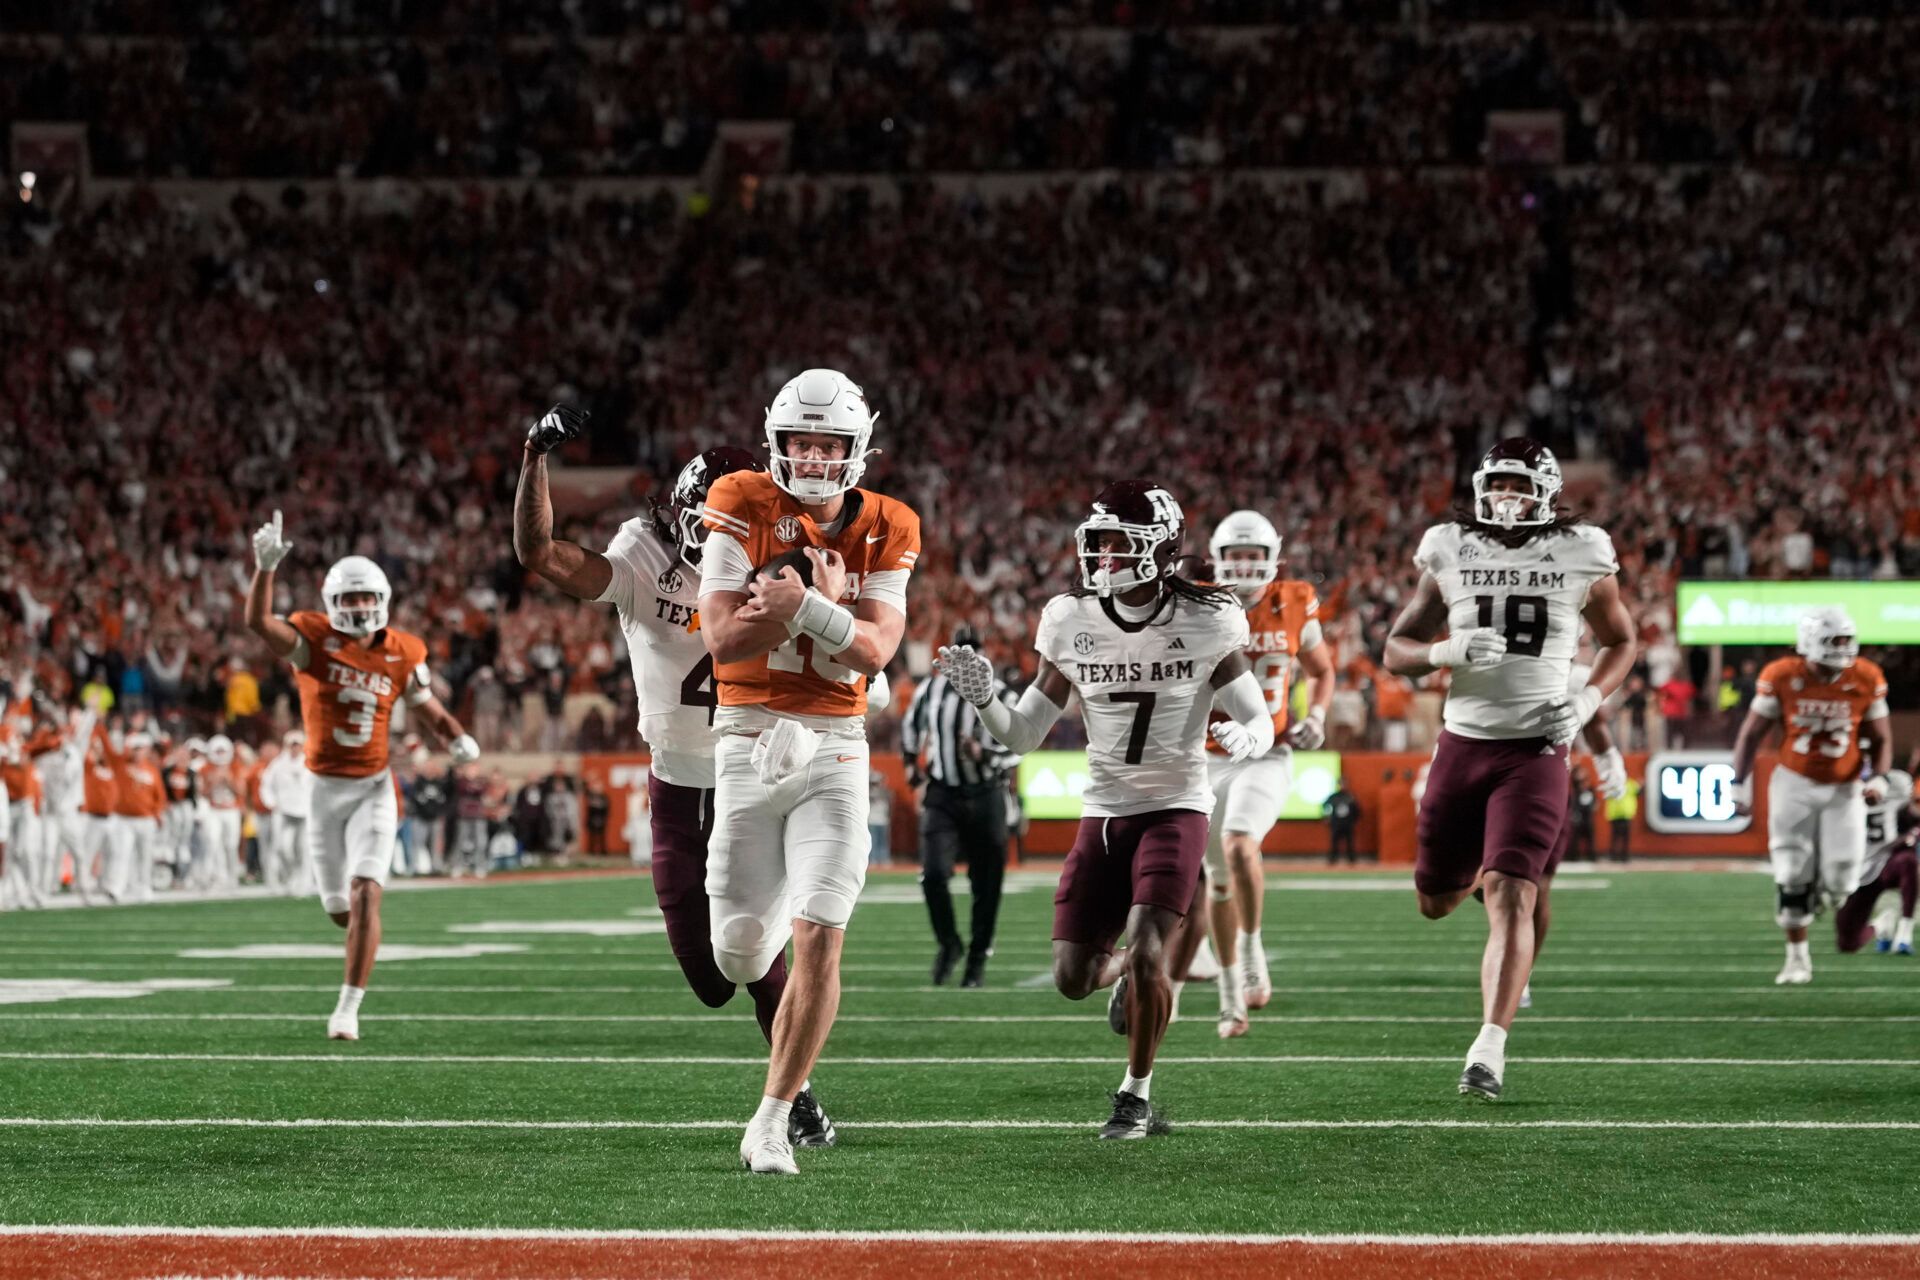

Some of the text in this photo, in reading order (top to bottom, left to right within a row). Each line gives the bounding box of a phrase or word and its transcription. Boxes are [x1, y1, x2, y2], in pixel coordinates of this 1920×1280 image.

[1460, 569, 1566, 588] TEXAS A&M
[1474, 594, 1549, 657] 18
[327, 662, 393, 697] TEXAS
[680, 652, 719, 727] 4
[1077, 660, 1194, 683] TEXAS A&M
[333, 687, 377, 748] 3
[1109, 691, 1156, 765] 7
[1796, 699, 1852, 717] TEXAS
[1791, 717, 1853, 760] 73
[1662, 763, 1736, 821] 40
